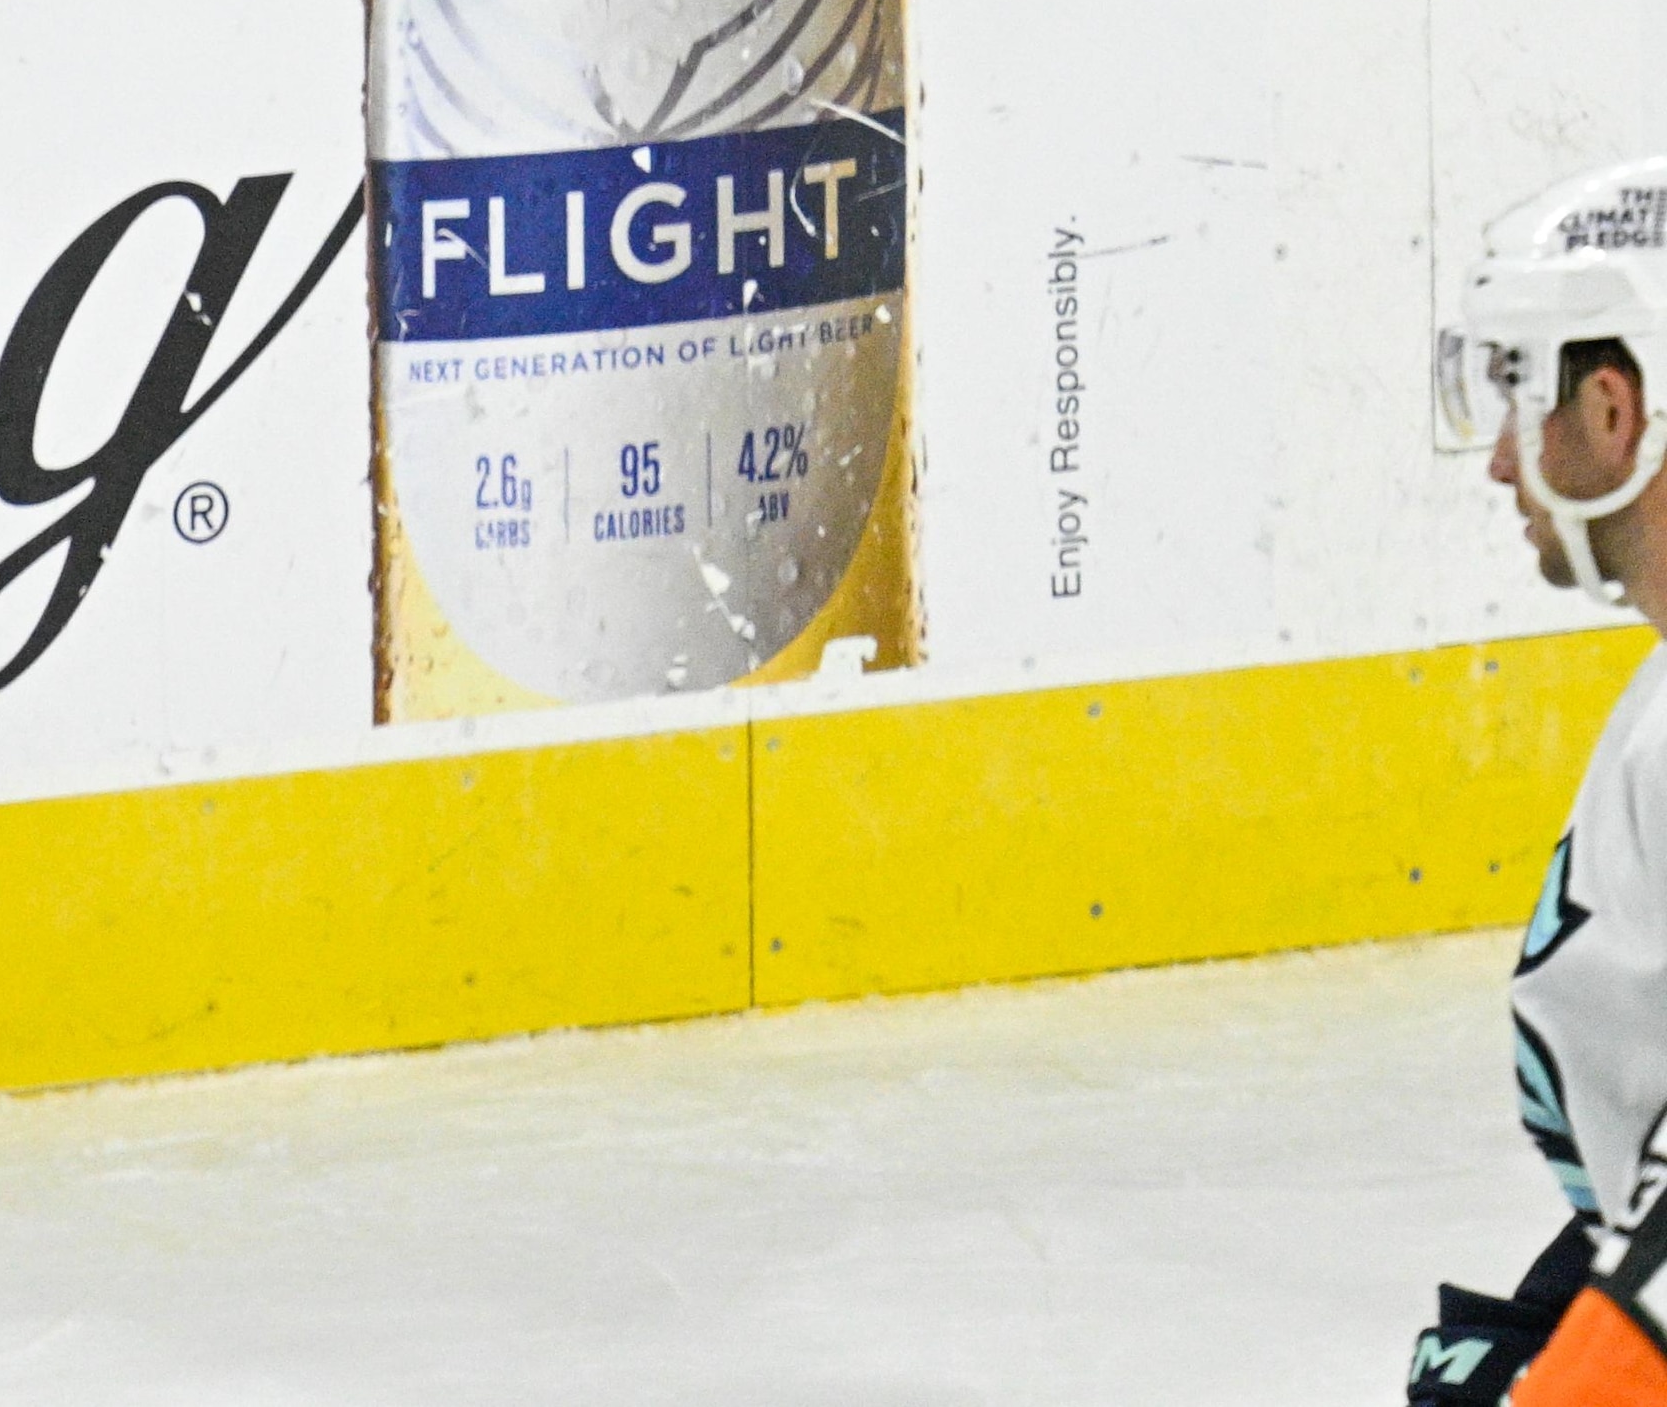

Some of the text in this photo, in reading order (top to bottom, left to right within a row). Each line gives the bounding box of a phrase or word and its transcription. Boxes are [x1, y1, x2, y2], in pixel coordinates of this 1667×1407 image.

[420, 160, 858, 301] FLIGHT
[408, 358, 464, 384] NEXT
[474, 341, 666, 382] GENERATION
[678, 336, 717, 363] OF
[1047, 213, 1090, 599] Enjoy Responsibly.
[475, 422, 809, 512] 2.6g 95 4.2%
[593, 504, 686, 542] CALORIES
